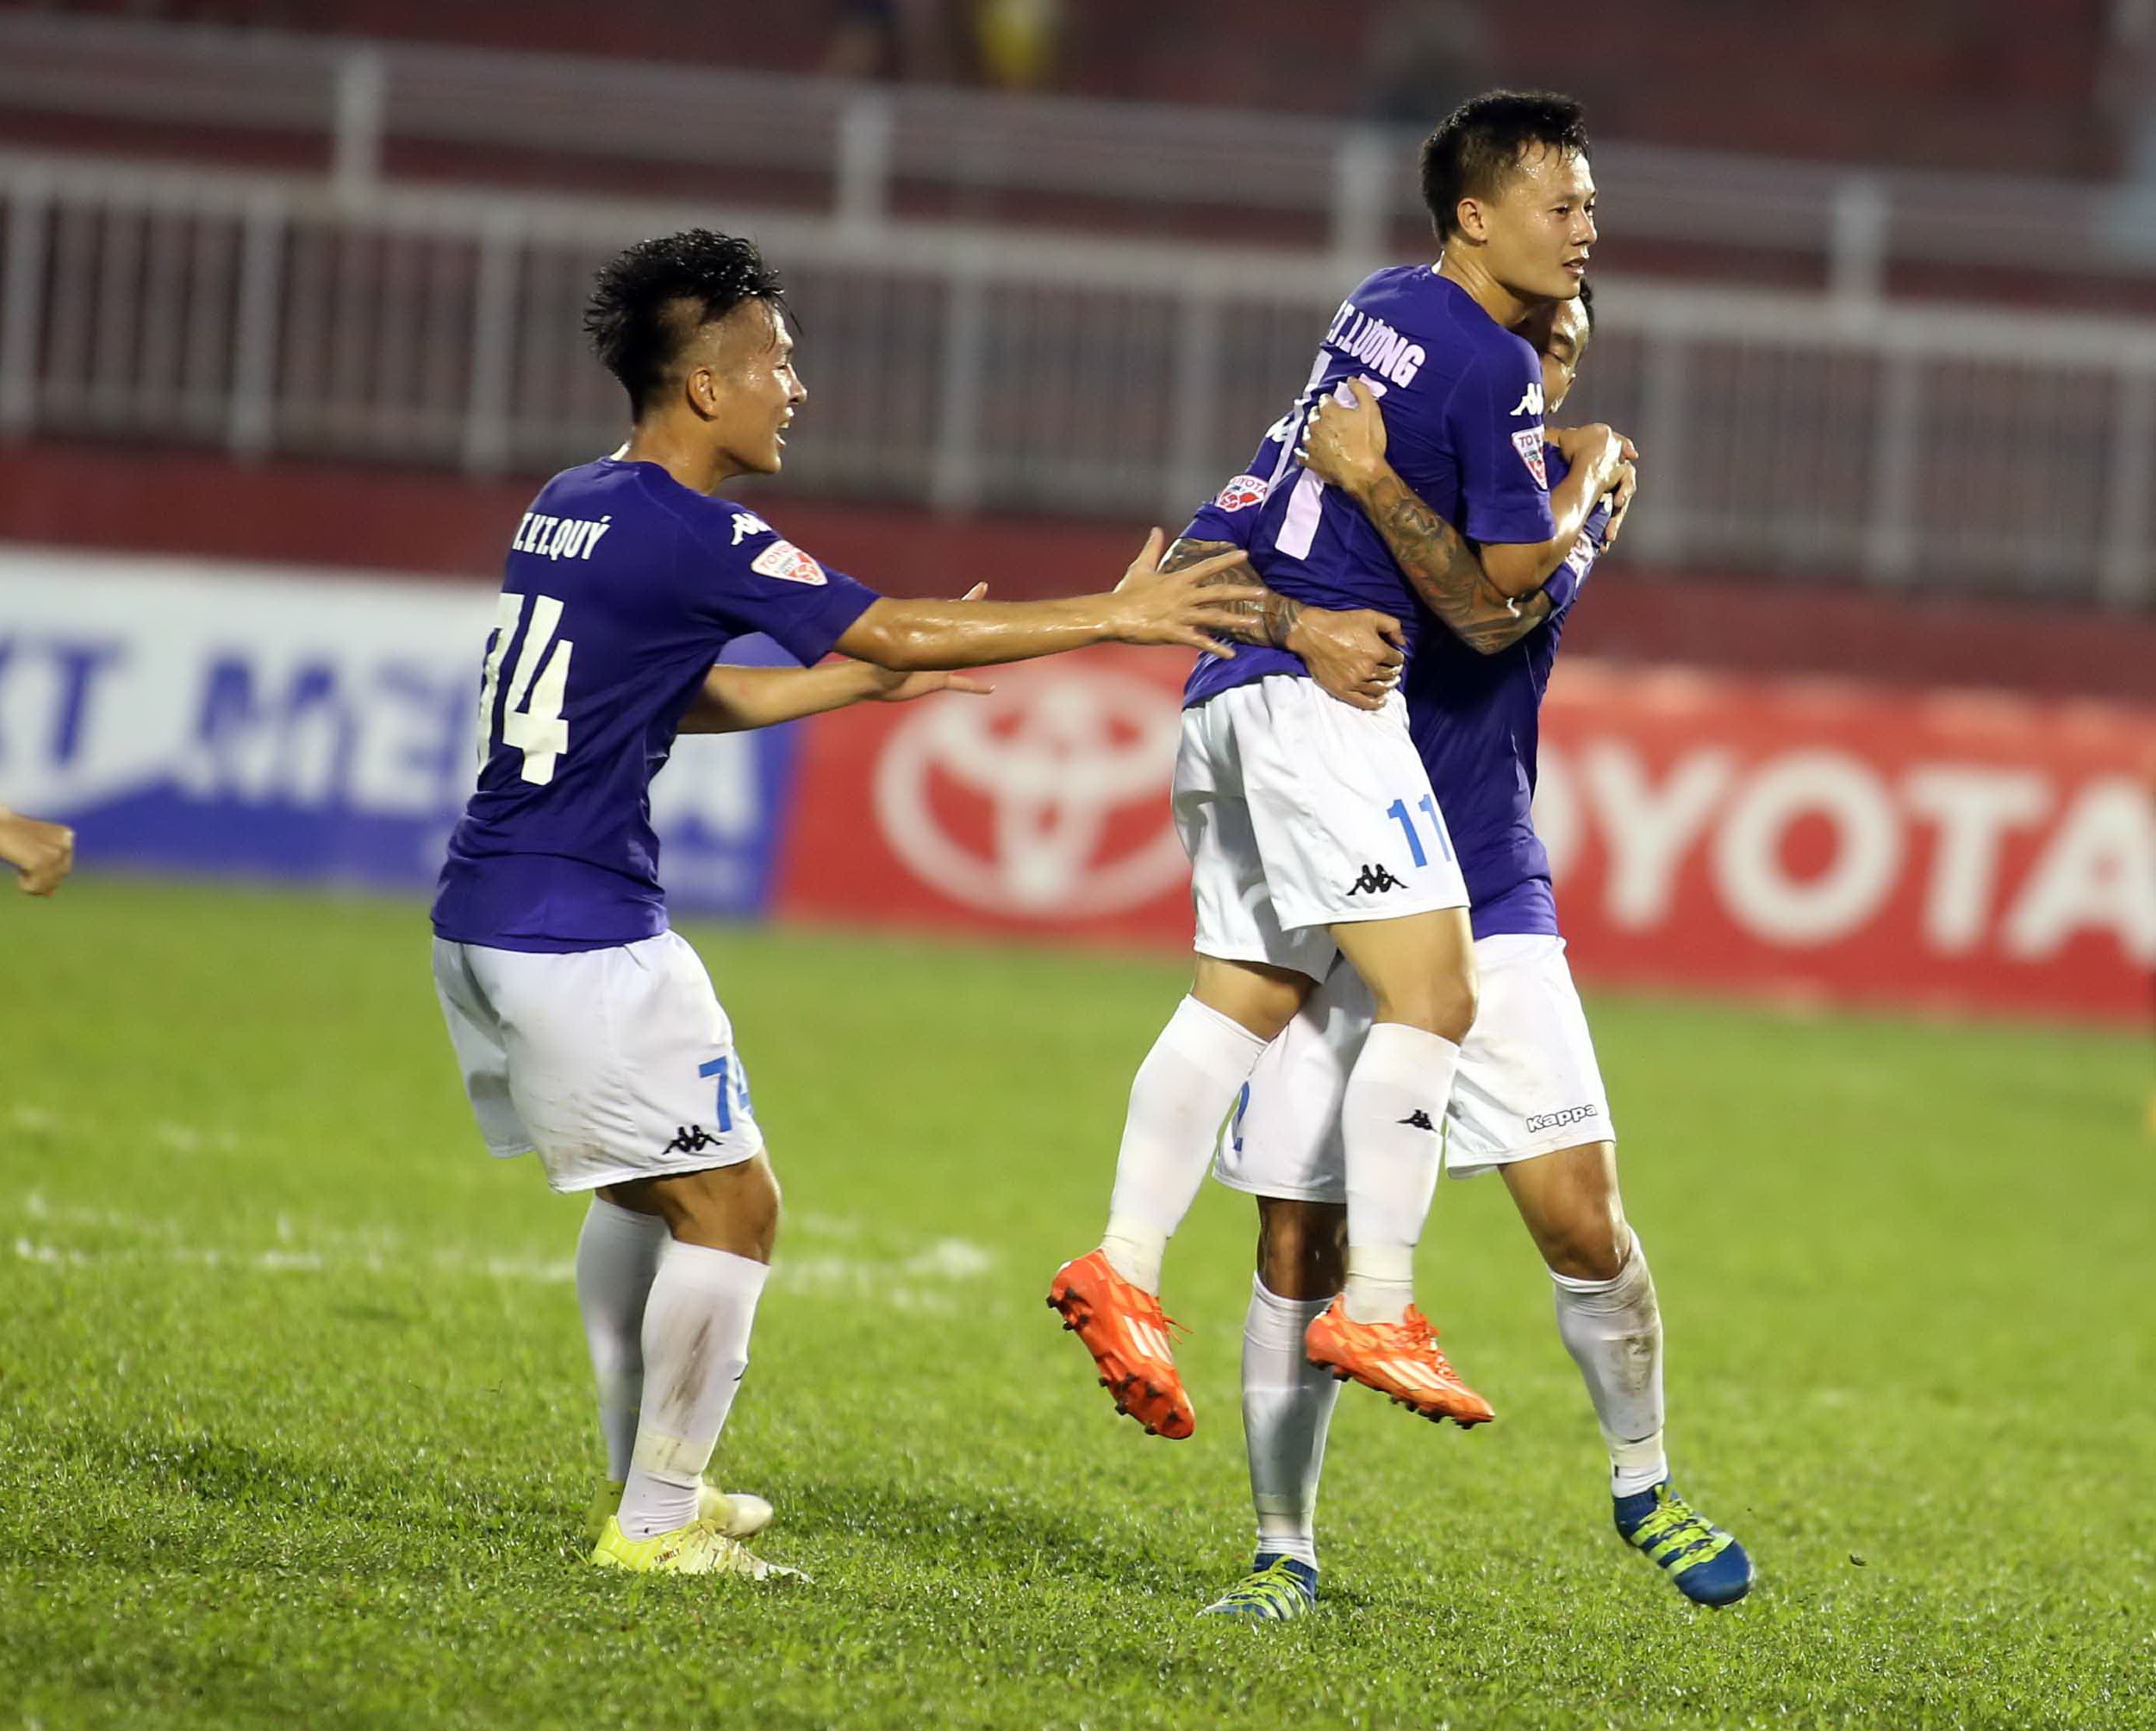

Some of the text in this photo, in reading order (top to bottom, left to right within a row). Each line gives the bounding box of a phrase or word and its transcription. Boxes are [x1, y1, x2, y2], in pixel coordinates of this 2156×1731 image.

[477, 592, 573, 786] 74
[1386, 794, 1451, 867] 11
[1533, 731, 2156, 971] YOTA
[1527, 1104, 1598, 1133] Kappa
